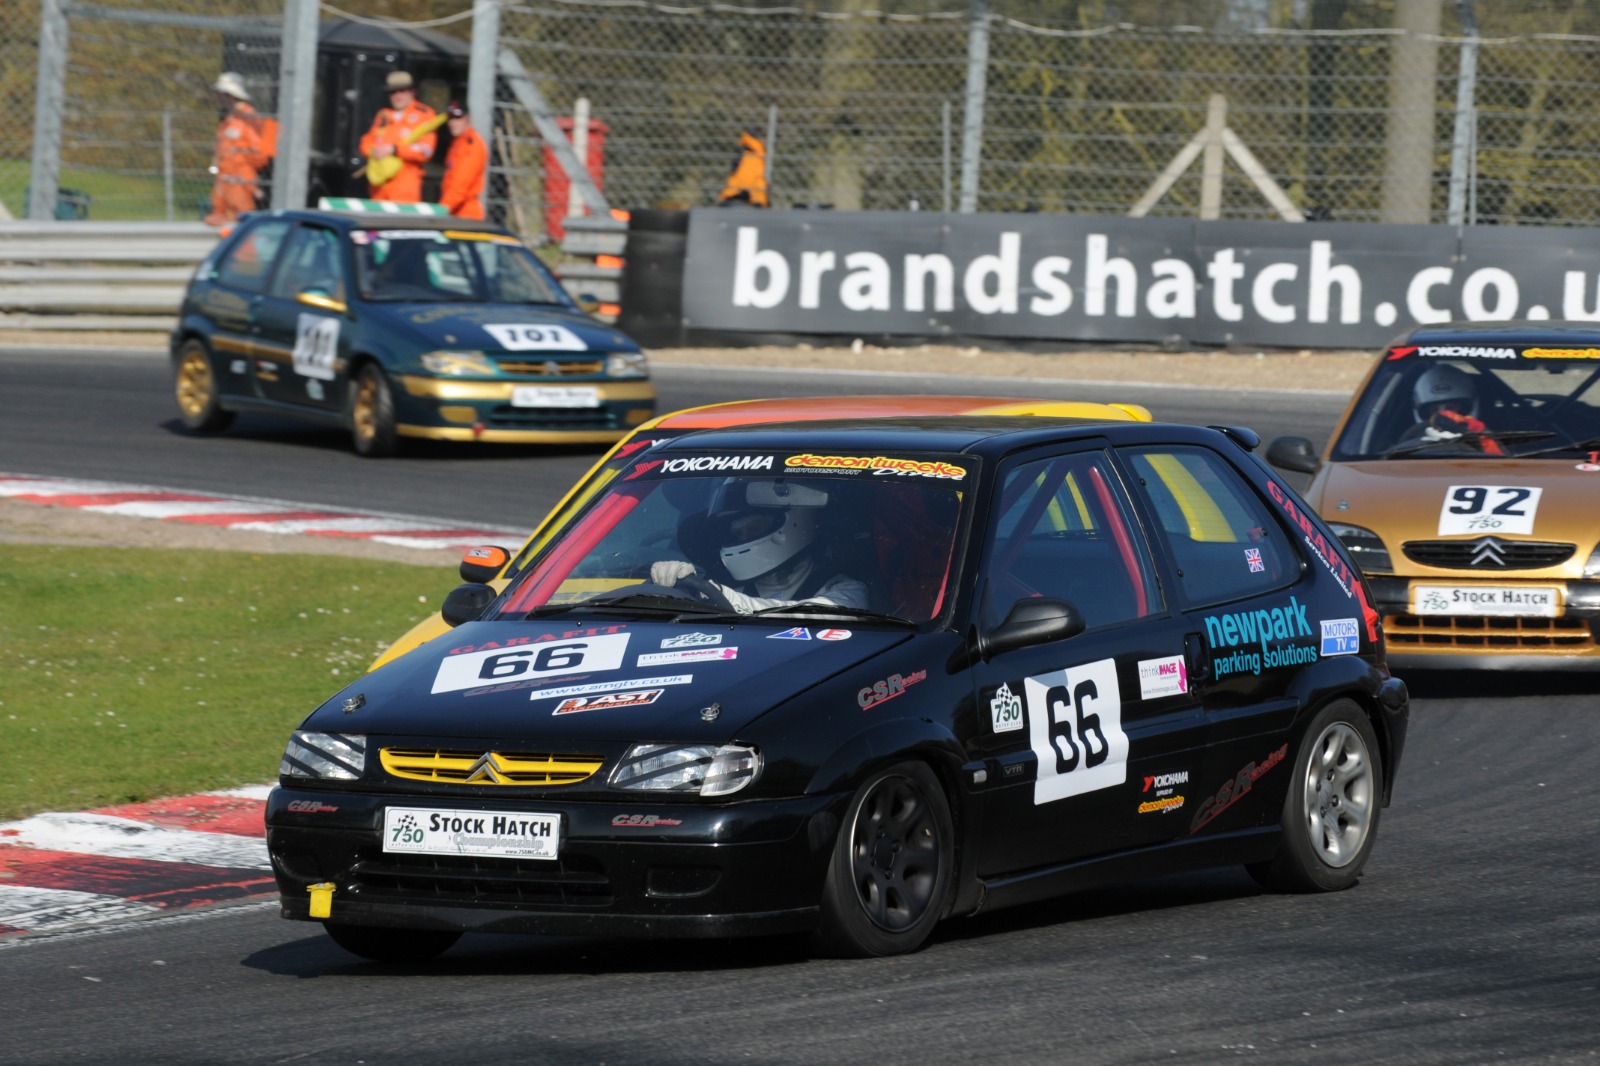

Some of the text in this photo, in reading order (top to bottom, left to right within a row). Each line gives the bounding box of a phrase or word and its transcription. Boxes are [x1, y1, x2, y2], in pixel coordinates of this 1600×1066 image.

[507, 329, 561, 342] 101
[1418, 347, 1516, 359] YOKOHAMA
[660, 456, 774, 473] YOKOHAMA
[785, 454, 967, 477] demon tweeks
[1449, 488, 1531, 516] 92
[1305, 535, 1352, 598] Services Limited
[1452, 590, 1548, 604] STOCK HATCH
[1204, 596, 1312, 652] newpark
[1324, 622, 1357, 637] MOTORS
[450, 625, 626, 654] GARAFIT
[822, 629, 848, 640] E
[1336, 637, 1347, 651] TV
[478, 643, 588, 679] 66
[1214, 645, 1317, 680] parking solutions
[540, 677, 682, 697] www.amgtv.co.uk
[559, 698, 651, 713] SUSPENSION
[590, 689, 657, 705] AST
[995, 701, 1020, 723] 750
[1046, 679, 1109, 775] 66
[1154, 771, 1189, 788] YOKOHAMA
[429, 813, 551, 837] STOCK HATCH
[392, 828, 424, 843] 750
